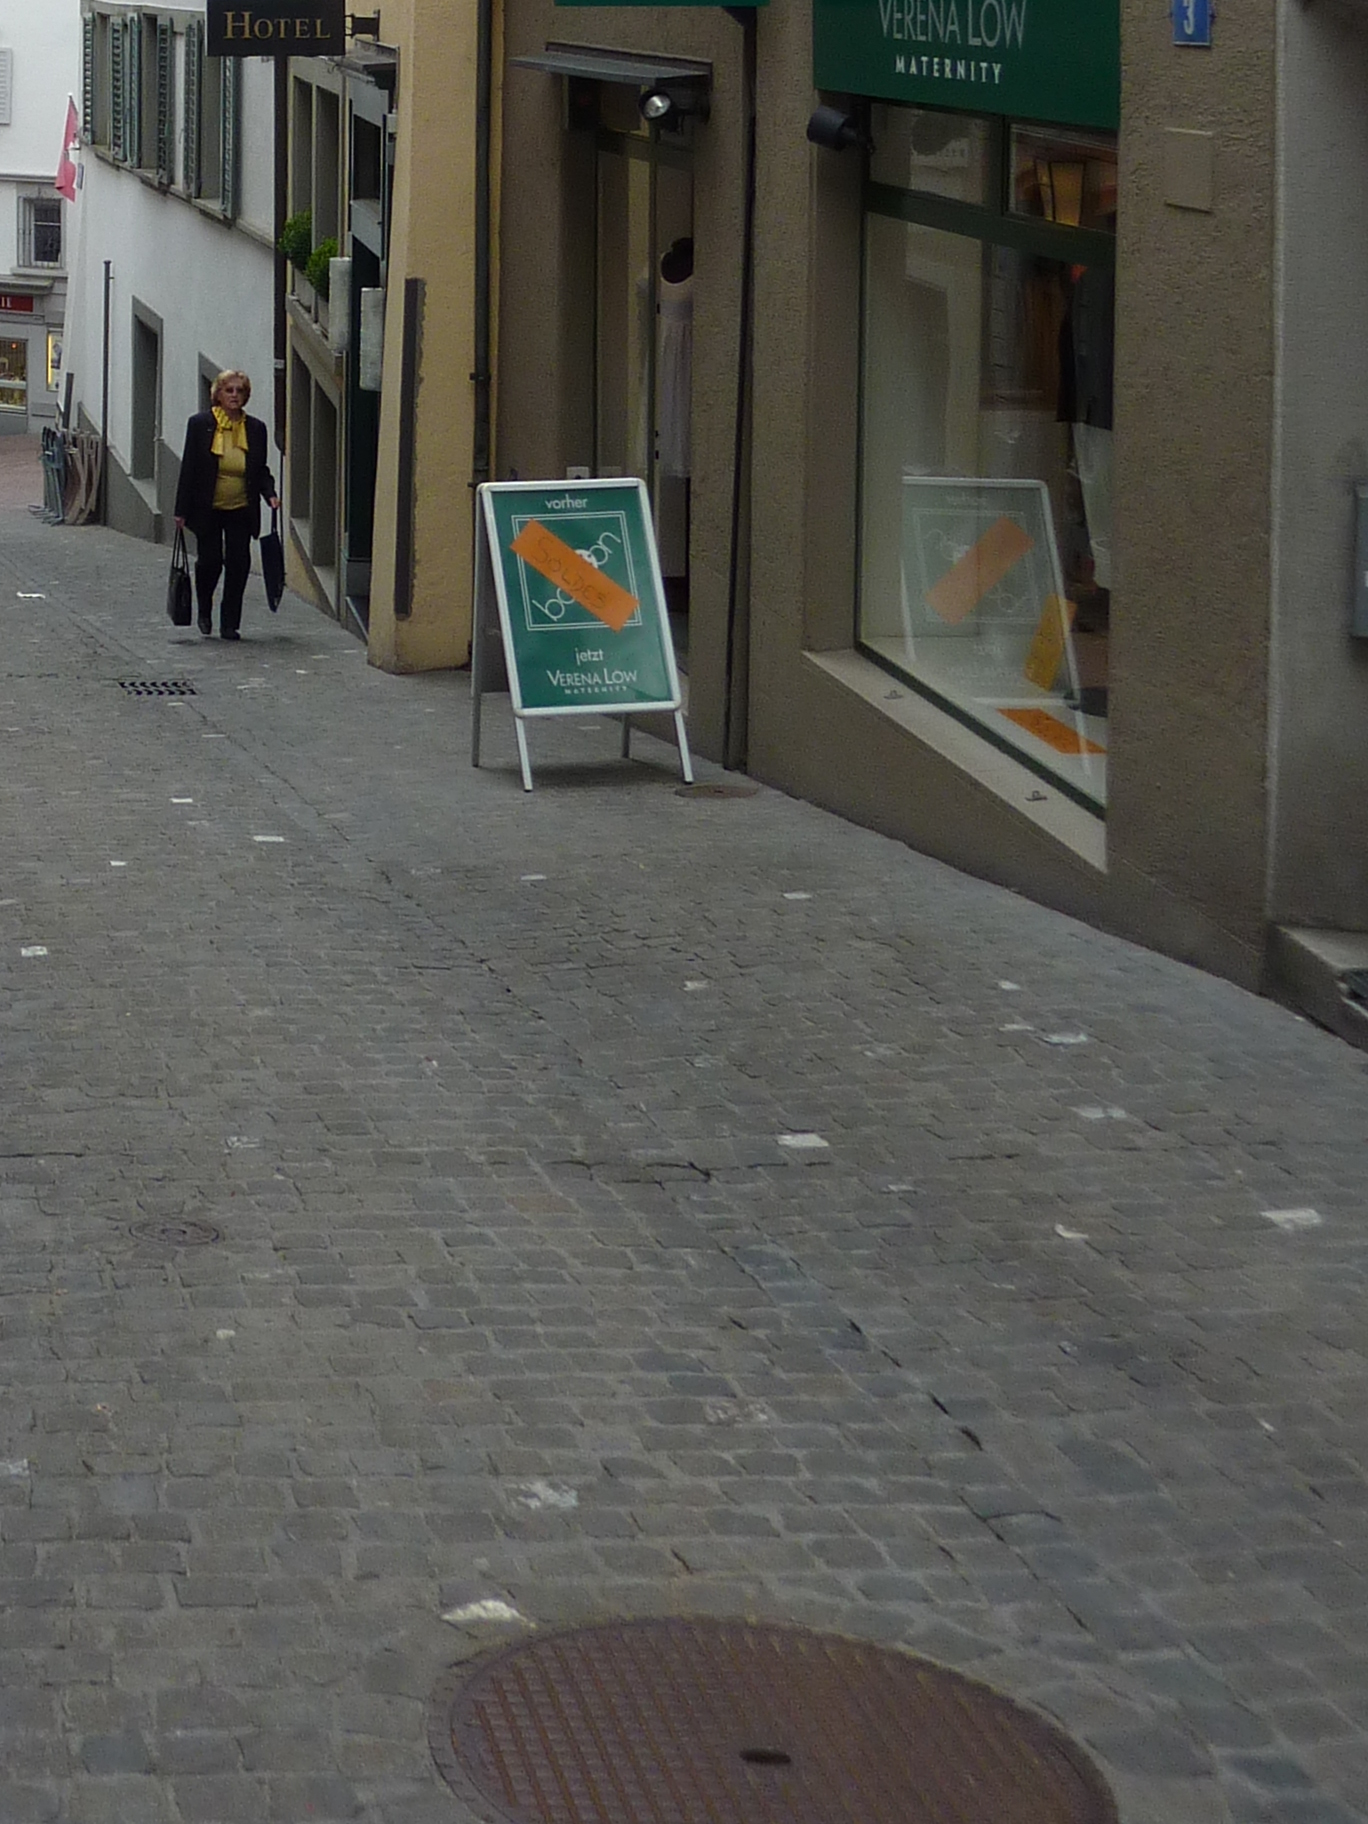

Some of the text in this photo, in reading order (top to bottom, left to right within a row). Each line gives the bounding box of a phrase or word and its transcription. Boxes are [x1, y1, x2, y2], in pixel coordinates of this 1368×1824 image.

[223, 11, 331, 39] HOTEL
[895, 54, 1001, 84] MATERNITY
[545, 494, 588, 509] vorher
[575, 647, 604, 666] jetzt
[546, 669, 602, 686] VERENA
